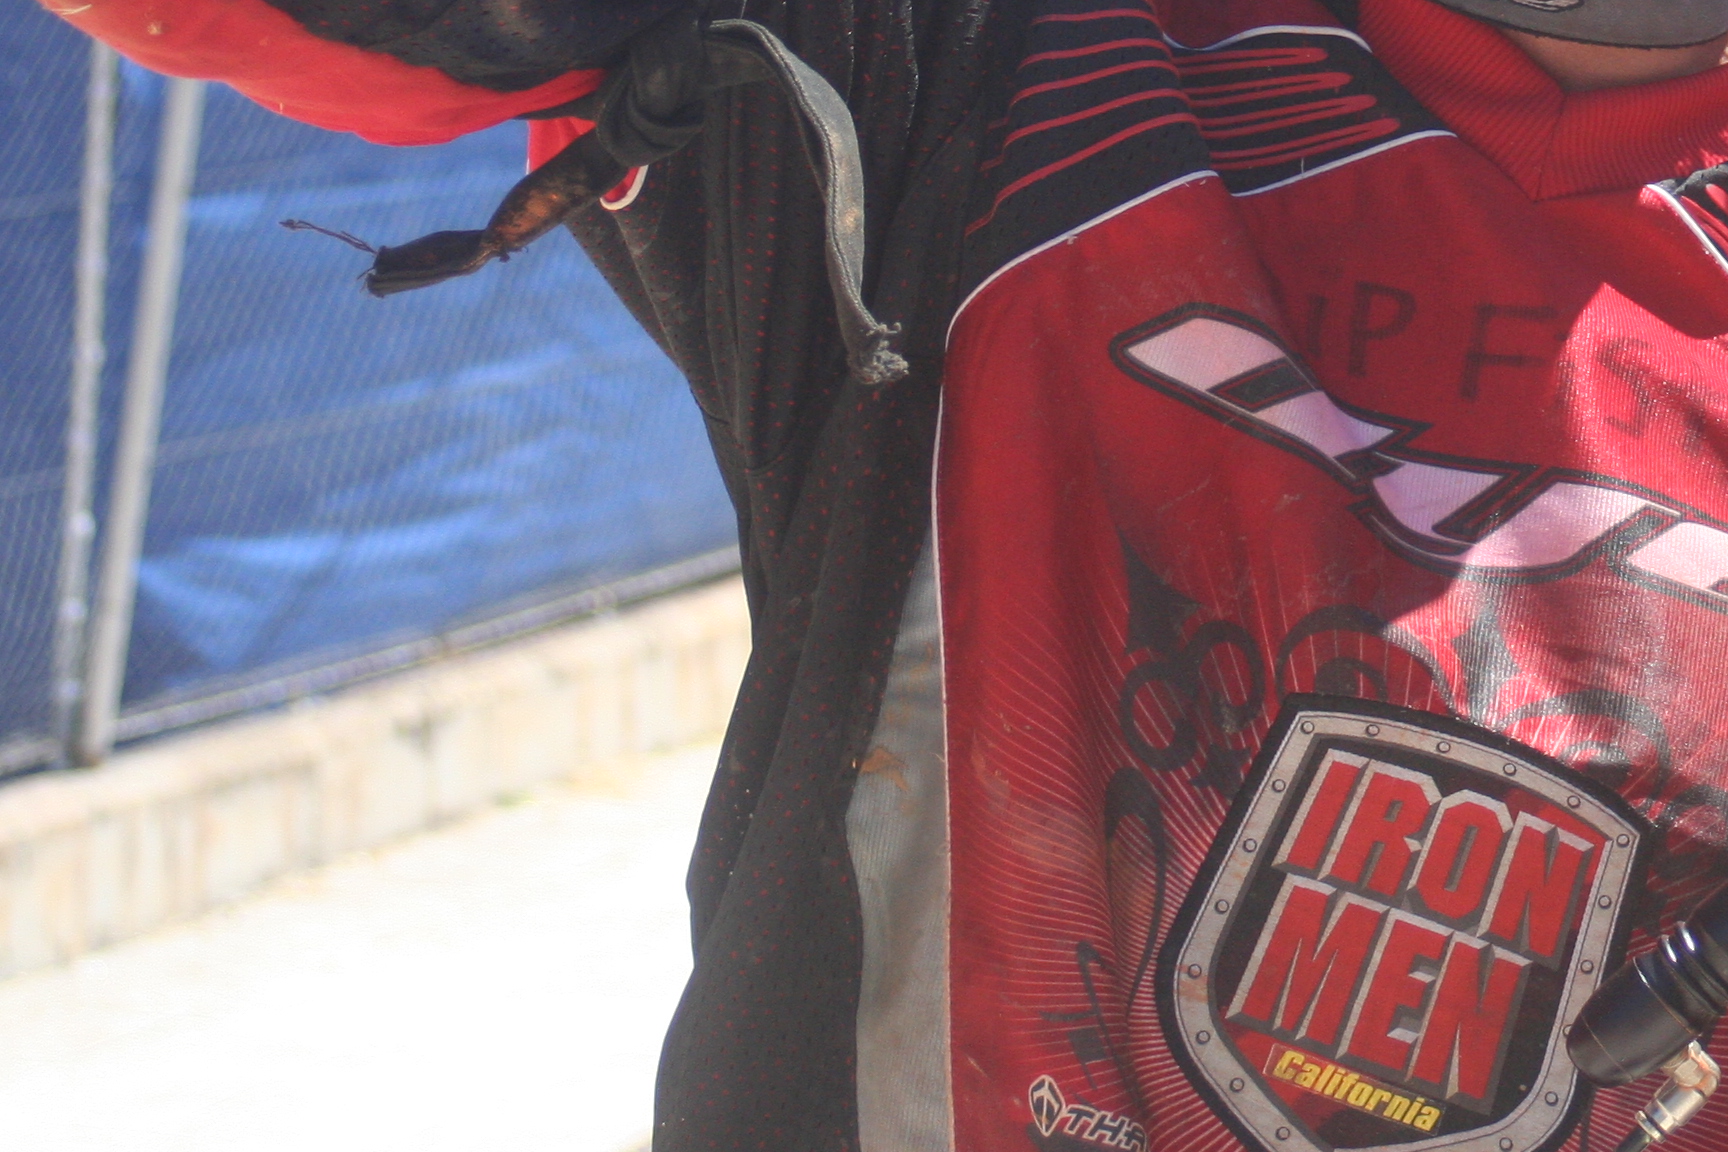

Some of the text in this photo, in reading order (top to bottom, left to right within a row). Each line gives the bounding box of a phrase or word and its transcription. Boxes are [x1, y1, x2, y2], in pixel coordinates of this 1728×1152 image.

[1271, 748, 1598, 970] IRON
[1225, 873, 1533, 1115] MEN
[1271, 1048, 1443, 1133] California
